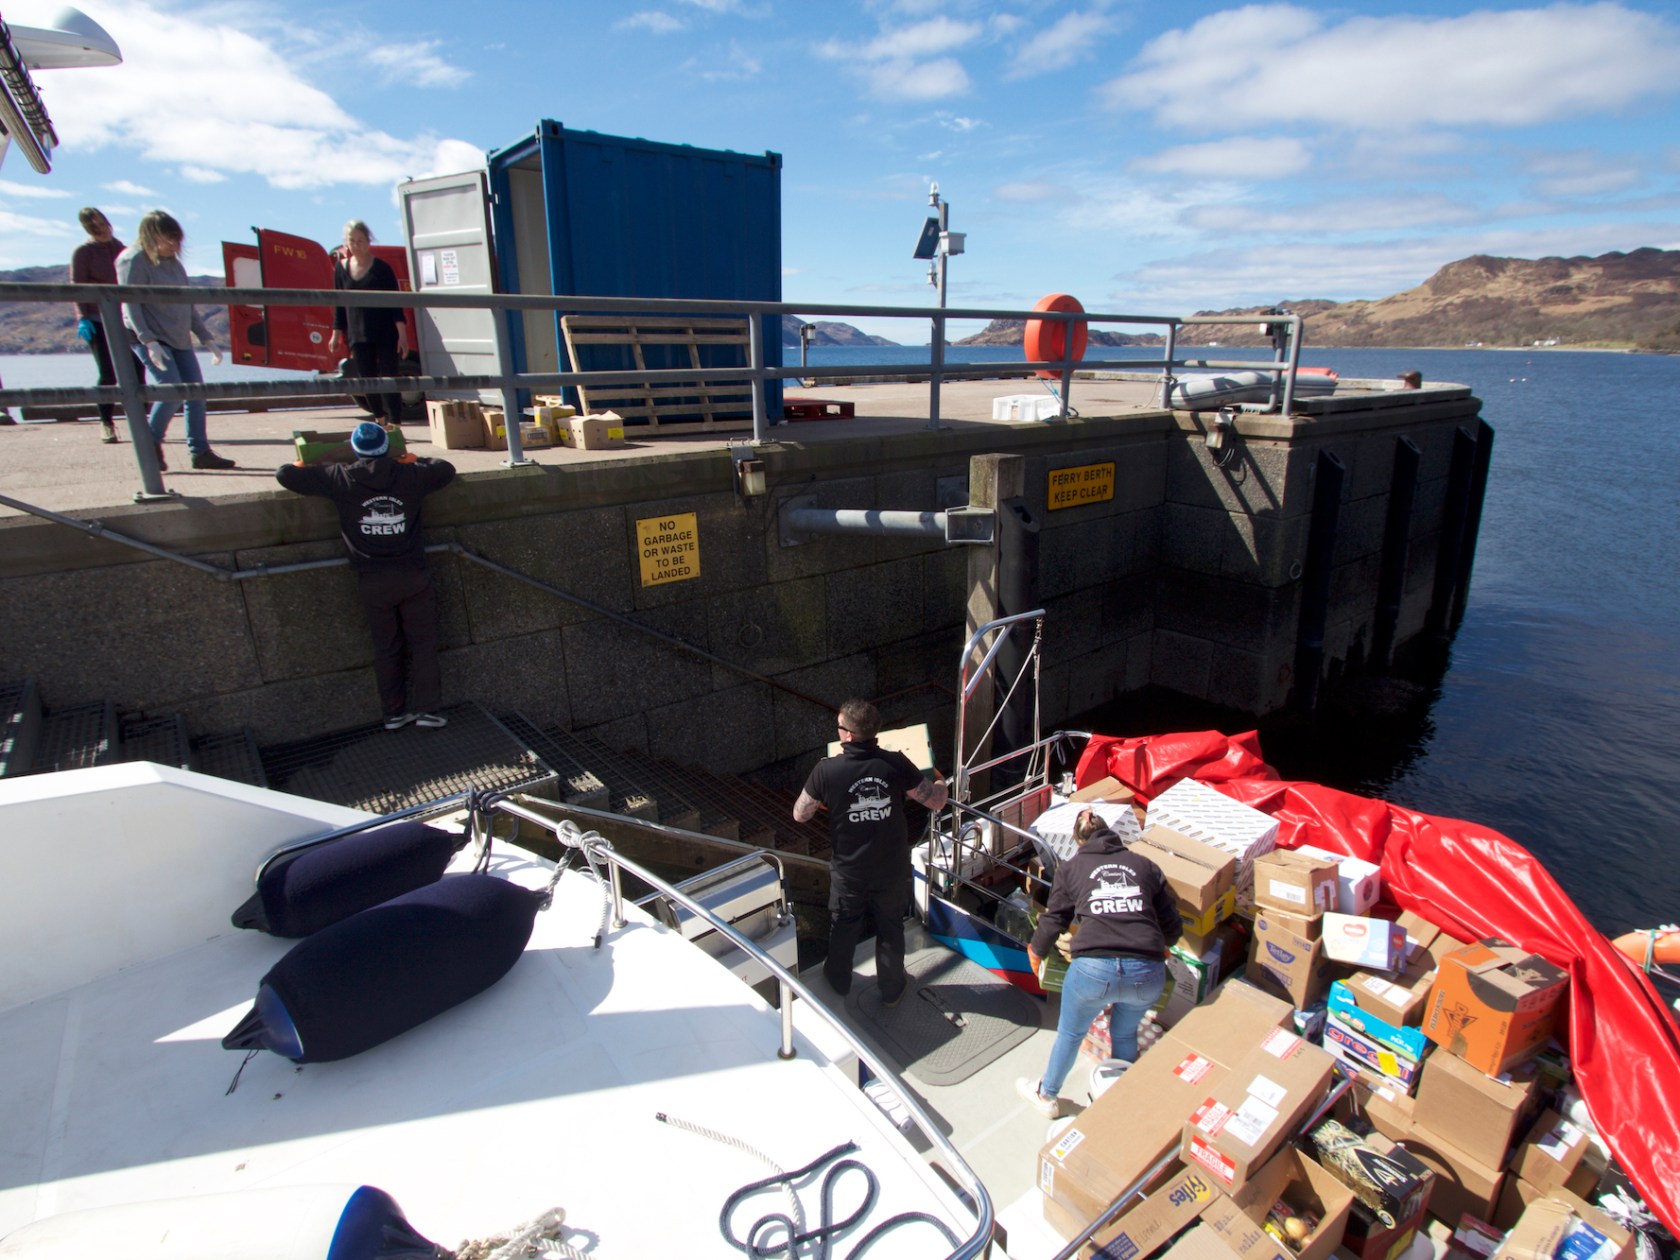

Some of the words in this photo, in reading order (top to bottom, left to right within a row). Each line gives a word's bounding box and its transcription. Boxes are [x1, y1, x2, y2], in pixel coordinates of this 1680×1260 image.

[1052, 471, 1081, 487] FERRY
[1084, 466, 1112, 481] BERTH
[1054, 489, 1078, 504] KEEP
[1080, 484, 1108, 499] CLEAR
[360, 522, 406, 535] CREW
[659, 520, 676, 532] NO
[644, 530, 693, 546] GARBAGE
[643, 548, 658, 558] OR
[661, 542, 695, 555] WASTE
[656, 558, 669, 568] TO
[672, 555, 685, 566] BE
[651, 566, 691, 581] LANDED
[848, 806, 892, 823] CREW
[1089, 864, 1118, 880] WESTERN
[1089, 899, 1143, 915] CREW
[1197, 1146, 1227, 1174] FRAGILE
